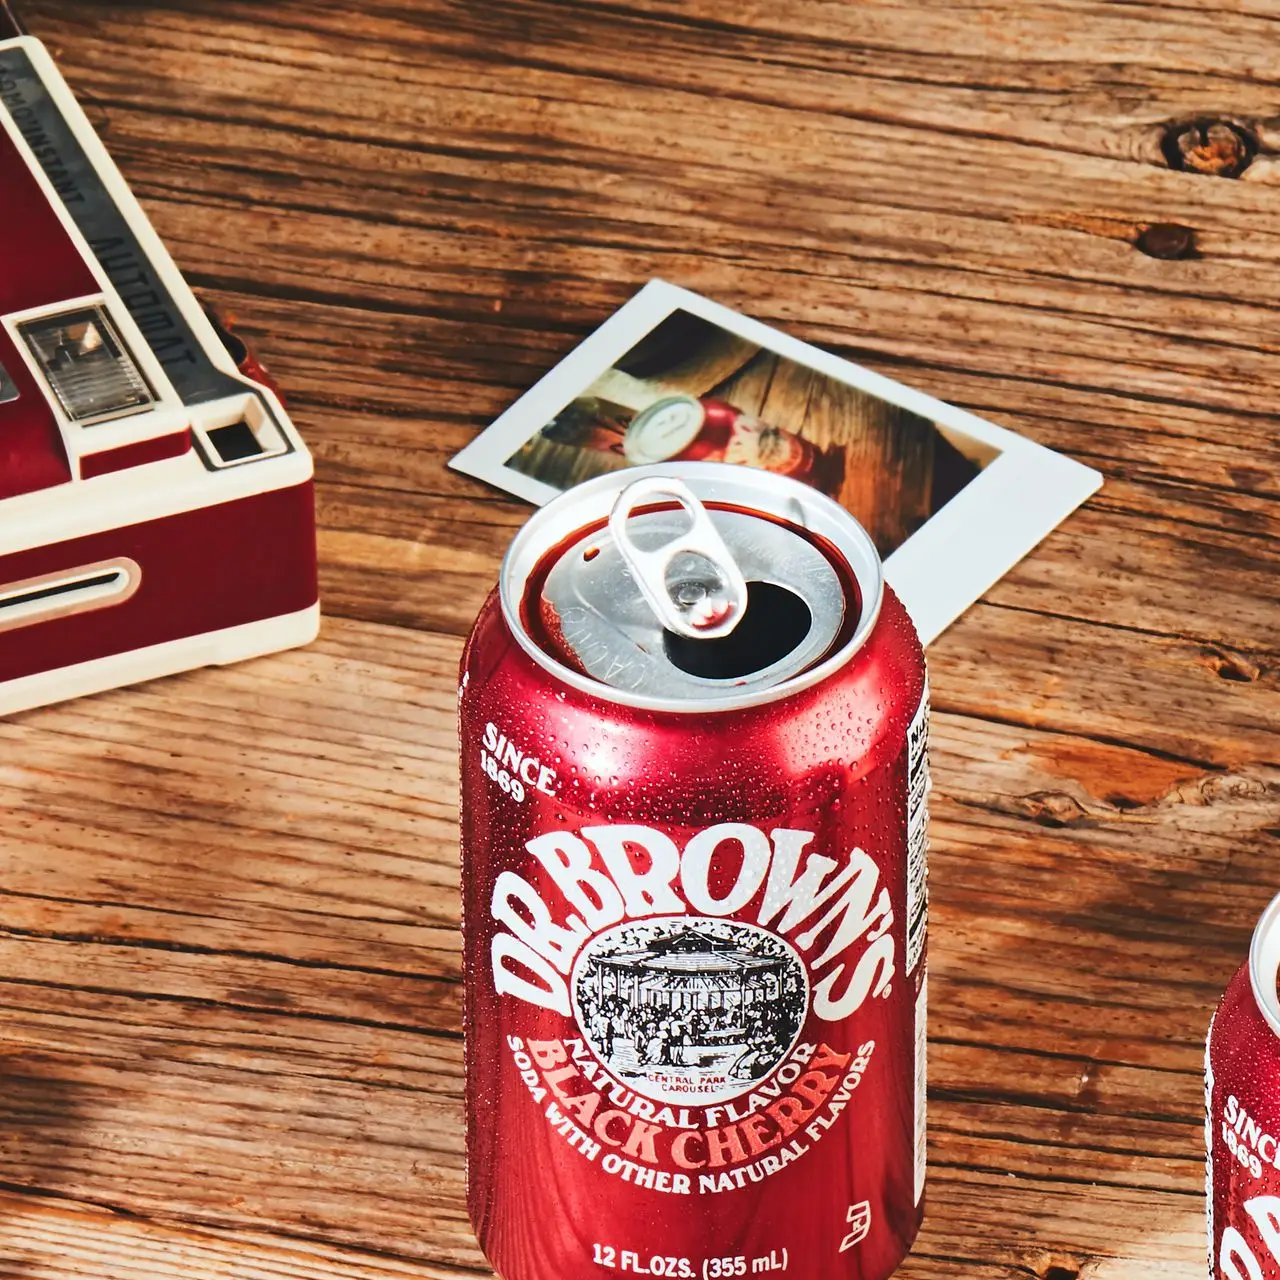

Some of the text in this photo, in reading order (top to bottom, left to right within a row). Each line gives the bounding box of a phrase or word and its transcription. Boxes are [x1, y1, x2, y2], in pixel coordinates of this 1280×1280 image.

[89, 236, 198, 365] AUTOMAT
[481, 750, 525, 802] 1869
[483, 722, 557, 797] SINCE
[525, 822, 895, 1022] BROWN'S
[506, 1034, 876, 1196] SODA WITH OTHER NATURAL FLAVORS
[526, 1036, 853, 1171] BLACK CHERRY
[563, 1036, 817, 1129] NATURAL FLAVOR
[648, 1074, 727, 1085] CENTRAL PARK
[662, 1084, 716, 1093] CAROUSEL
[1222, 1121, 1263, 1179] 1869
[592, 1243, 616, 1270] 12
[753, 1247, 790, 1275] mL)
